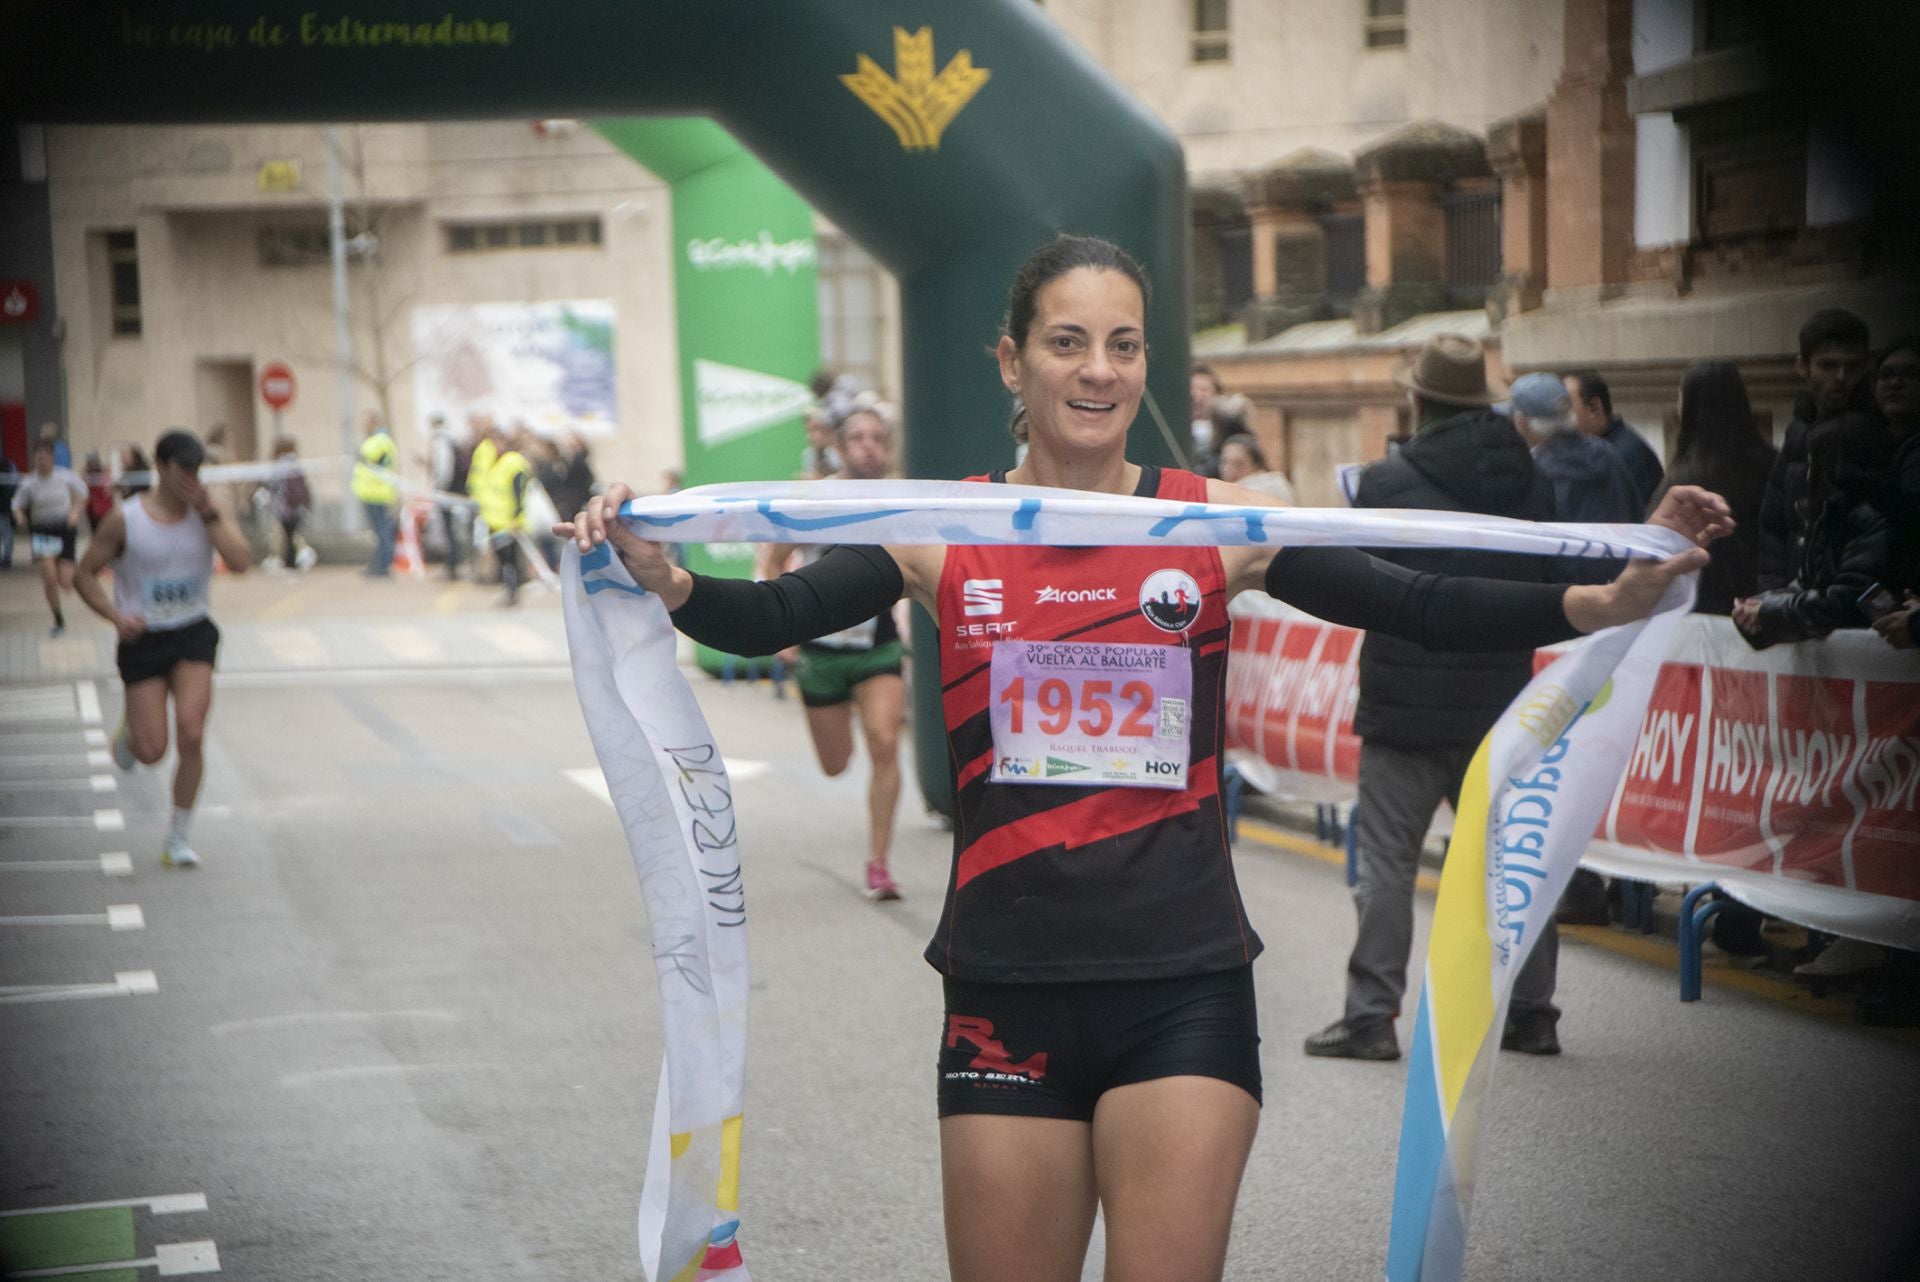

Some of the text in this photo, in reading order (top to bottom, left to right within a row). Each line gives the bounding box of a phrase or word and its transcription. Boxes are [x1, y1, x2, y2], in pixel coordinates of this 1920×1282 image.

[248, 15, 289, 46] de
[299, 12, 514, 47] Extremadura
[957, 621, 1017, 636] SEAT
[1027, 653, 1166, 669] VUELTA AL BALUARTE
[1054, 645, 1100, 656] CROSS
[1105, 646, 1166, 657] POPULAR
[1000, 677, 1154, 737] 1952
[1630, 709, 1694, 785] HOY
[1708, 717, 1765, 798] HOY
[1145, 760, 1181, 776] HOY
[1776, 728, 1850, 808] HOY
